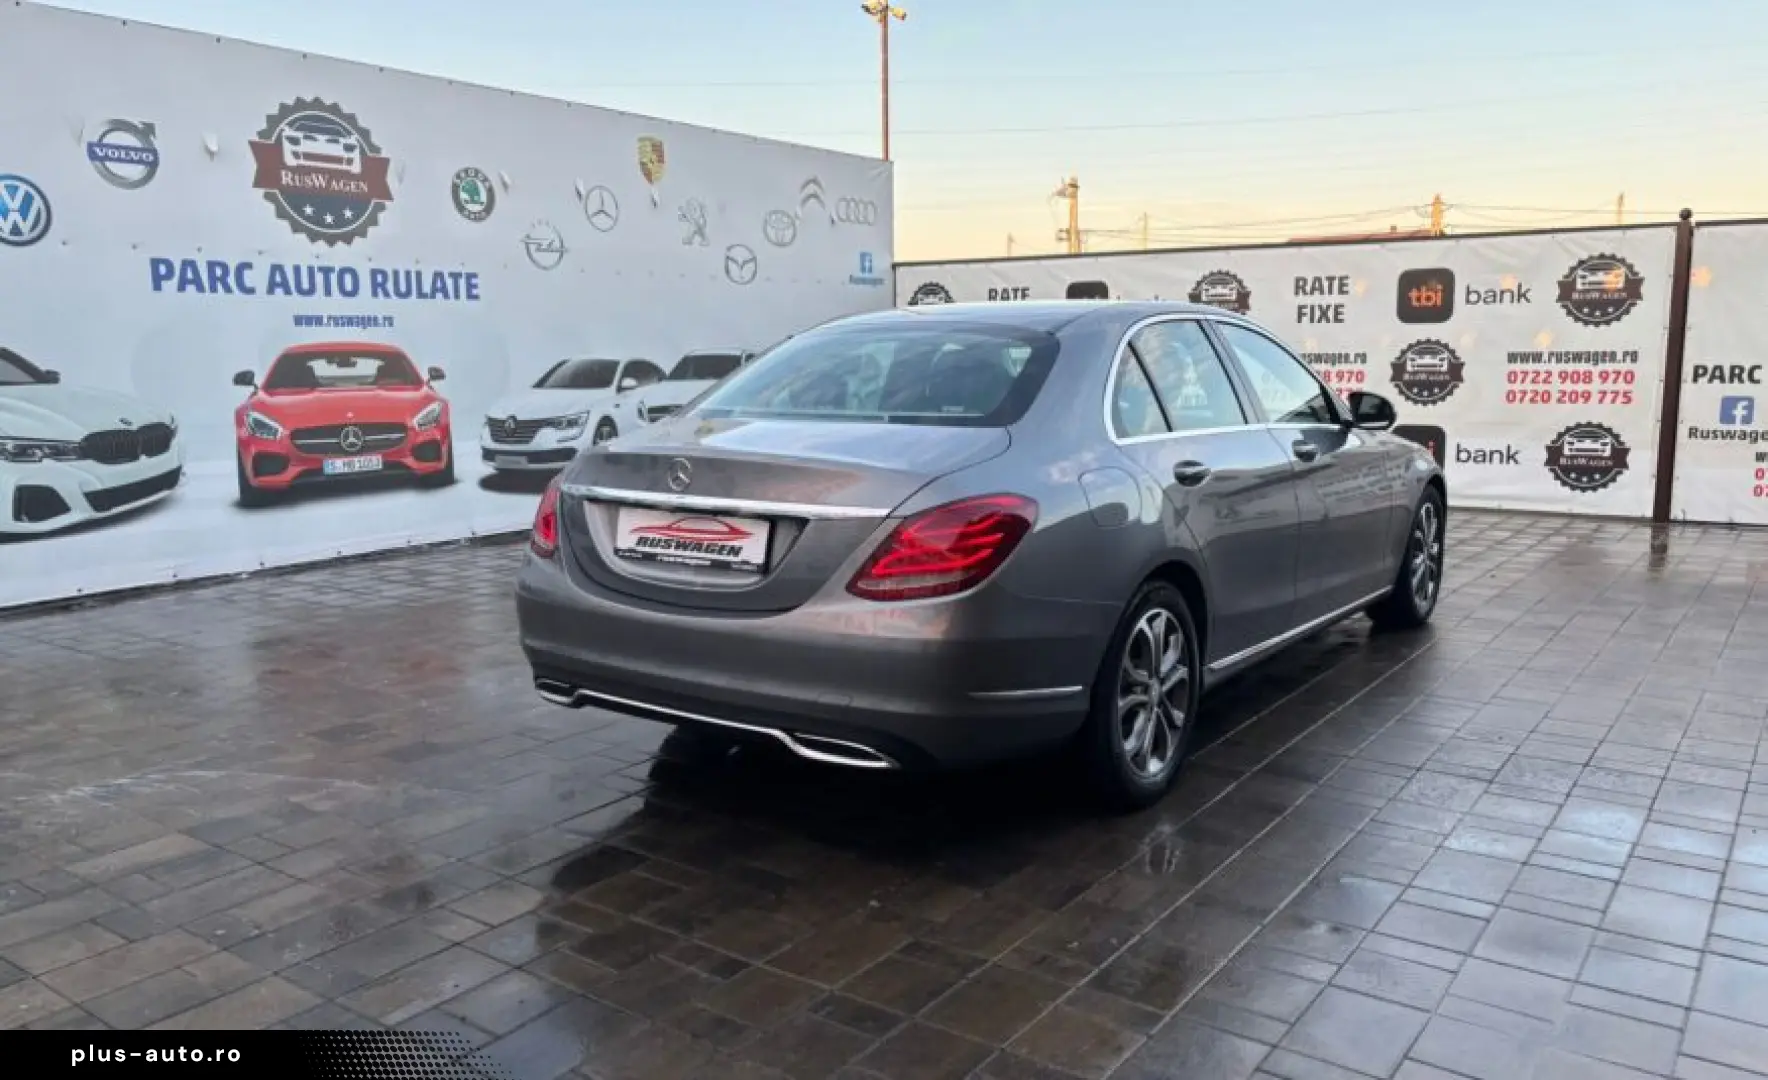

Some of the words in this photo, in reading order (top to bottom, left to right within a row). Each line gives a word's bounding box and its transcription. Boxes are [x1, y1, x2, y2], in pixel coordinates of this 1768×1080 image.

[93, 146, 154, 162] VOLVO
[150, 257, 256, 295] PARC
[266, 264, 360, 299] AUTO
[369, 268, 480, 300] RULATE
[1294, 275, 1350, 296] RATE
[1408, 284, 1444, 307] tbi
[1465, 282, 1532, 306] bank
[293, 314, 394, 329] www.ruswagen.ro
[1297, 304, 1346, 324] FIXE
[1507, 350, 1638, 366] www.ruswagen.ro
[1335, 369, 1366, 384] 970
[1507, 370, 1553, 385] 0722
[1557, 370, 1593, 385] 908
[1598, 370, 1635, 385] 970
[1691, 364, 1763, 385] PARC
[1505, 389, 1552, 404] 0720
[1555, 389, 1592, 404] 209
[1597, 389, 1632, 404] 775
[1455, 443, 1521, 466] bank
[636, 536, 744, 558] RUSWAGEN
